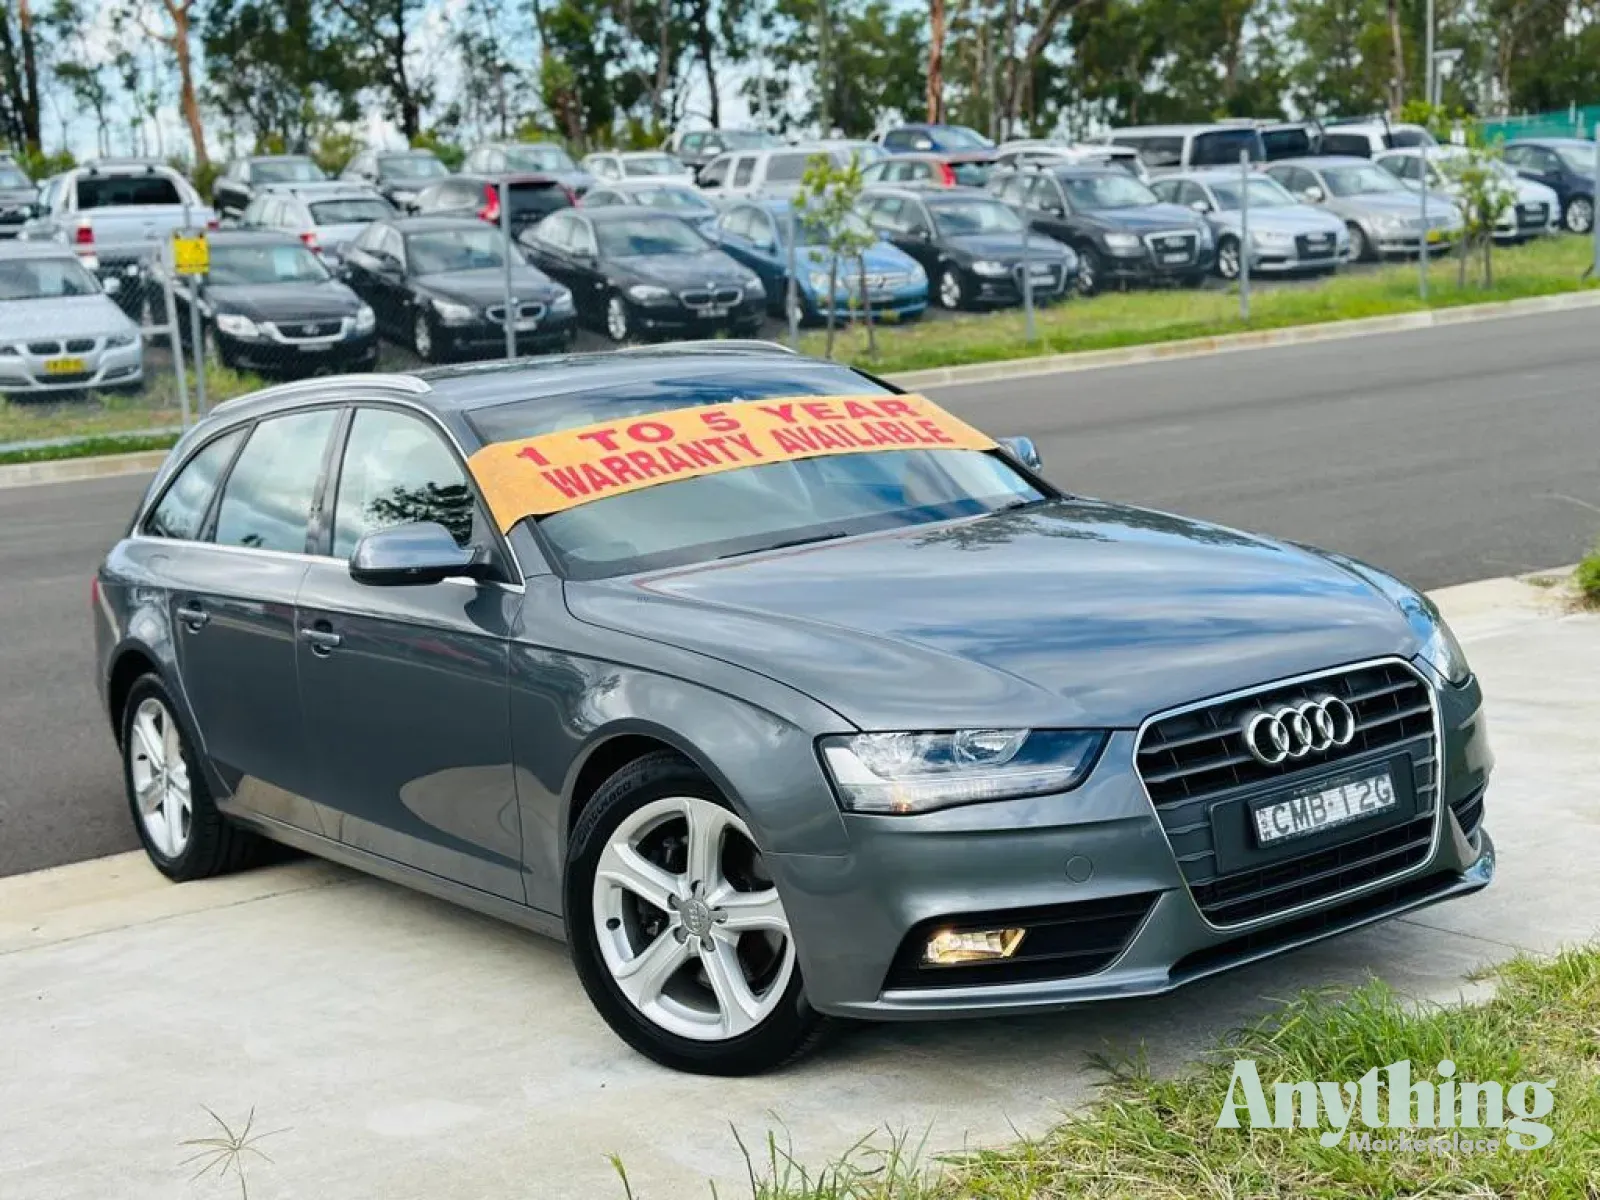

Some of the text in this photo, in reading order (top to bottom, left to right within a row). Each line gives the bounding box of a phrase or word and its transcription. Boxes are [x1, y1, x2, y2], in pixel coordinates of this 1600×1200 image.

[516, 400, 922, 467] 1 TO 5 YEAR
[540, 419, 956, 499] WARRANTY AVAILABLE
